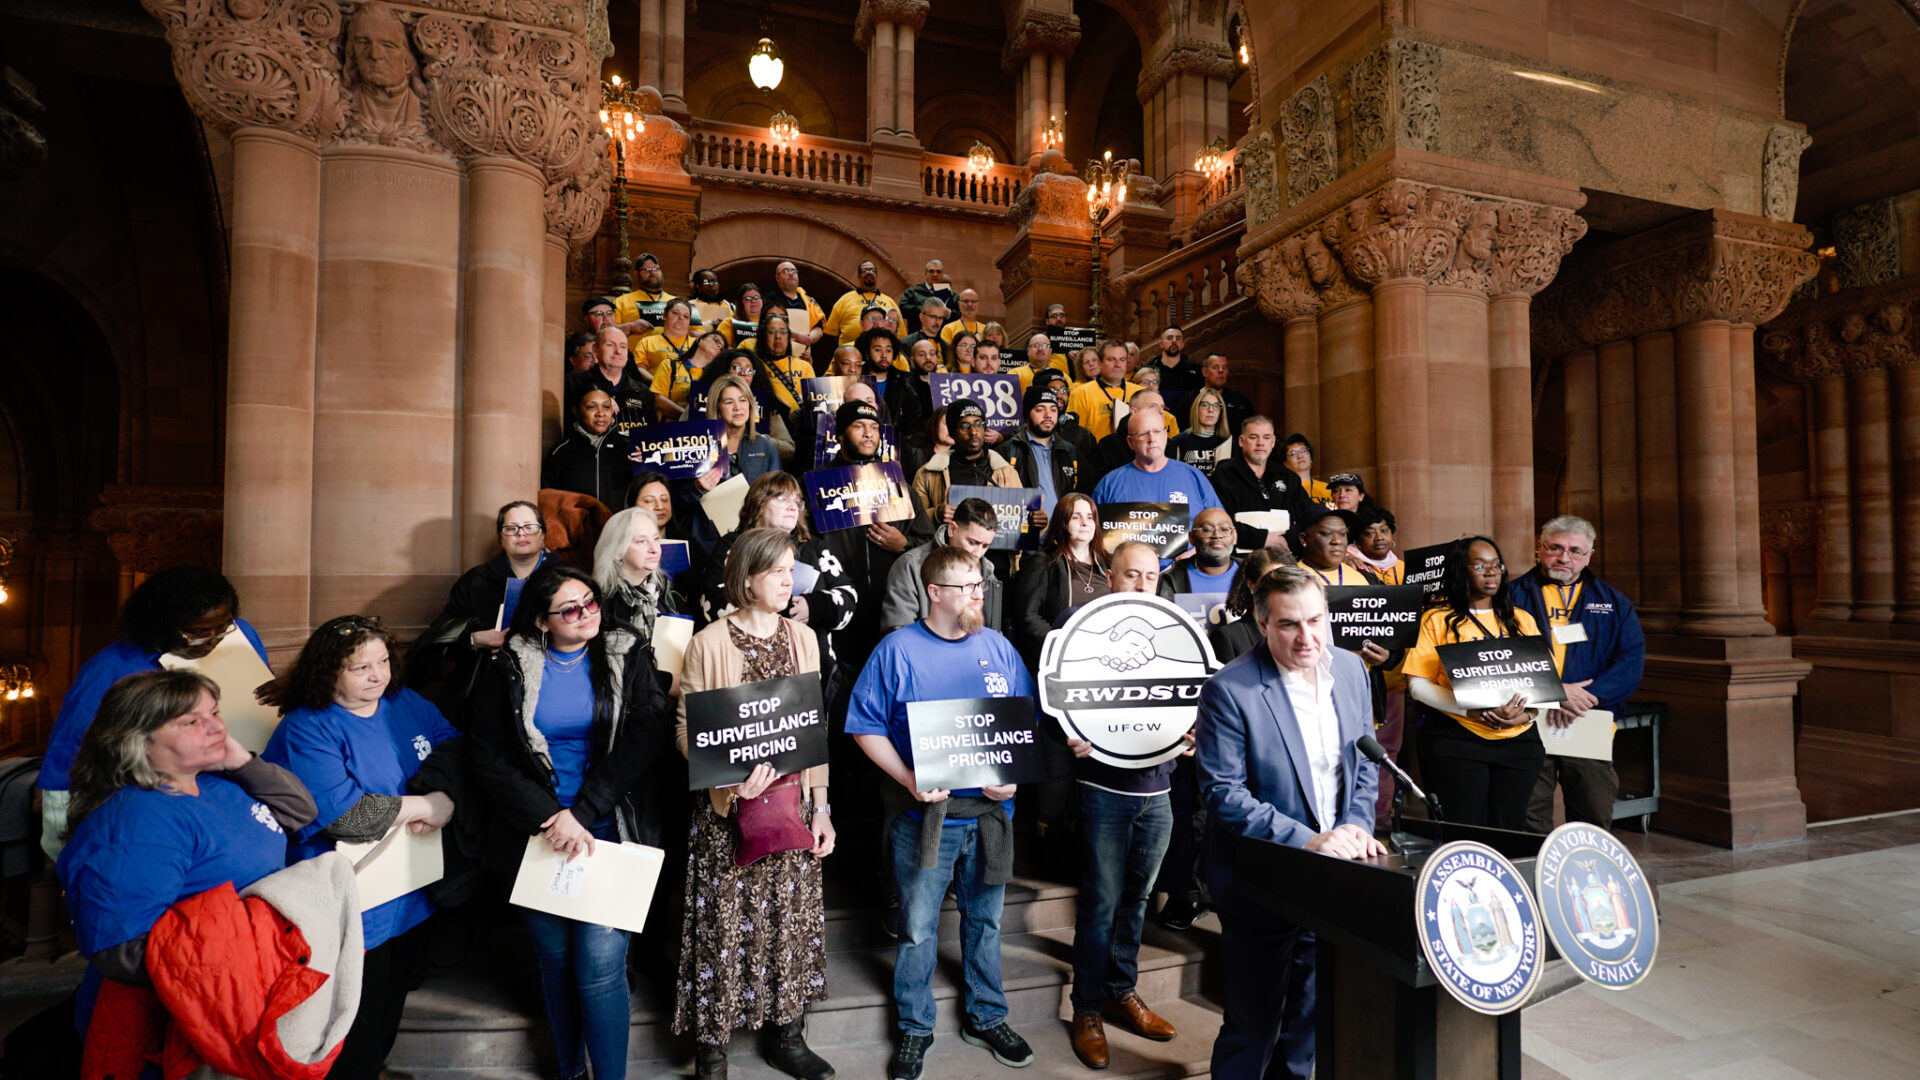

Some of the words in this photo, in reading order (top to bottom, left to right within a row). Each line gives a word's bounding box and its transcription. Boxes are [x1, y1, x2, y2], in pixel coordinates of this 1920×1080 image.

[1049, 335, 1094, 343] SURVEILLANCE
[939, 378, 952, 406] CAL
[951, 378, 1018, 418] 338
[986, 418, 1020, 427] U/UFCW
[641, 437, 674, 452] Local
[676, 435, 708, 447] 1500
[671, 450, 708, 462] UFCW
[1193, 450, 1214, 460] UF
[819, 482, 854, 499] Local
[854, 492, 888, 507] UFCW
[992, 503, 1021, 516] 1500
[1129, 510, 1159, 520] STOP
[1102, 521, 1185, 534] SURVEILLANCE
[1121, 532, 1167, 545] PRICING
[1425, 555, 1445, 568] STOP
[1405, 567, 1445, 585] SURVEILL
[1352, 597, 1387, 608] STOP
[1329, 611, 1417, 622] URVEILLANCE
[1341, 626, 1394, 637] PRICING
[1477, 649, 1513, 662] STOP
[1452, 660, 1551, 679] SURVEILLANCE
[984, 676, 1009, 694] 338
[1479, 677, 1535, 690] PRICING
[1064, 684, 1202, 703] RWDSU
[738, 696, 782, 719] STOP
[696, 709, 819, 748] SURVEILLANCE
[954, 713, 996, 729] STOP
[1107, 722, 1162, 733] UFCW
[918, 730, 1034, 751] SURVEILLANCE
[729, 735, 797, 764] PRICING
[947, 750, 1014, 768] PRICING
[1543, 849, 1564, 888] NEW
[1559, 829, 1599, 854] YORK
[1600, 838, 1641, 886] STATE
[1430, 853, 1507, 893] ASSEMBLY
[1432, 939, 1471, 991] STATE
[1471, 983, 1495, 1000] OF
[1494, 974, 1525, 1000] NEW
[1519, 921, 1536, 980] YORK
[1588, 956, 1642, 983] SENATE
